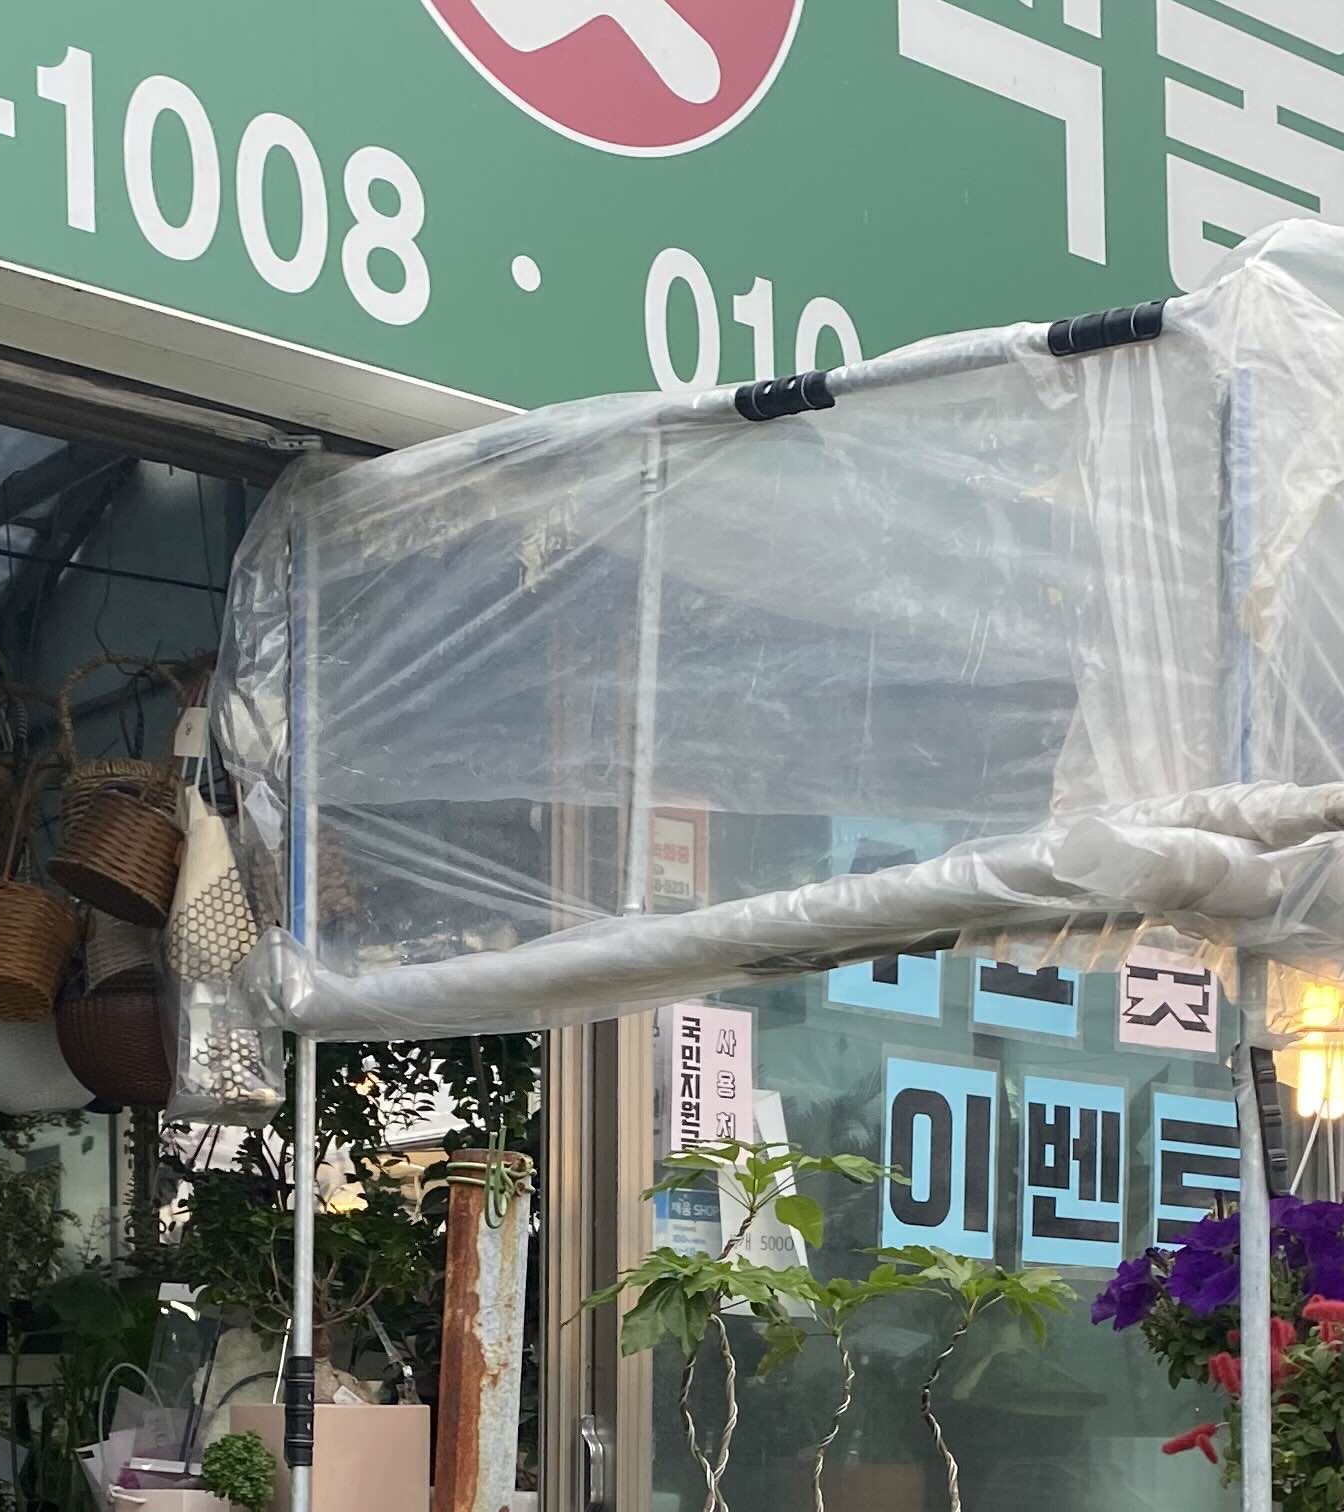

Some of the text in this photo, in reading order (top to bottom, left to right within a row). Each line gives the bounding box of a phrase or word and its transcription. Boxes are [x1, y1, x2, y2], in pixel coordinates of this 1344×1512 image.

[716, 1029, 737, 1140] 사용처
[890, 1087, 1241, 1245] 이벤트
[759, 1235, 795, 1252] 5000
